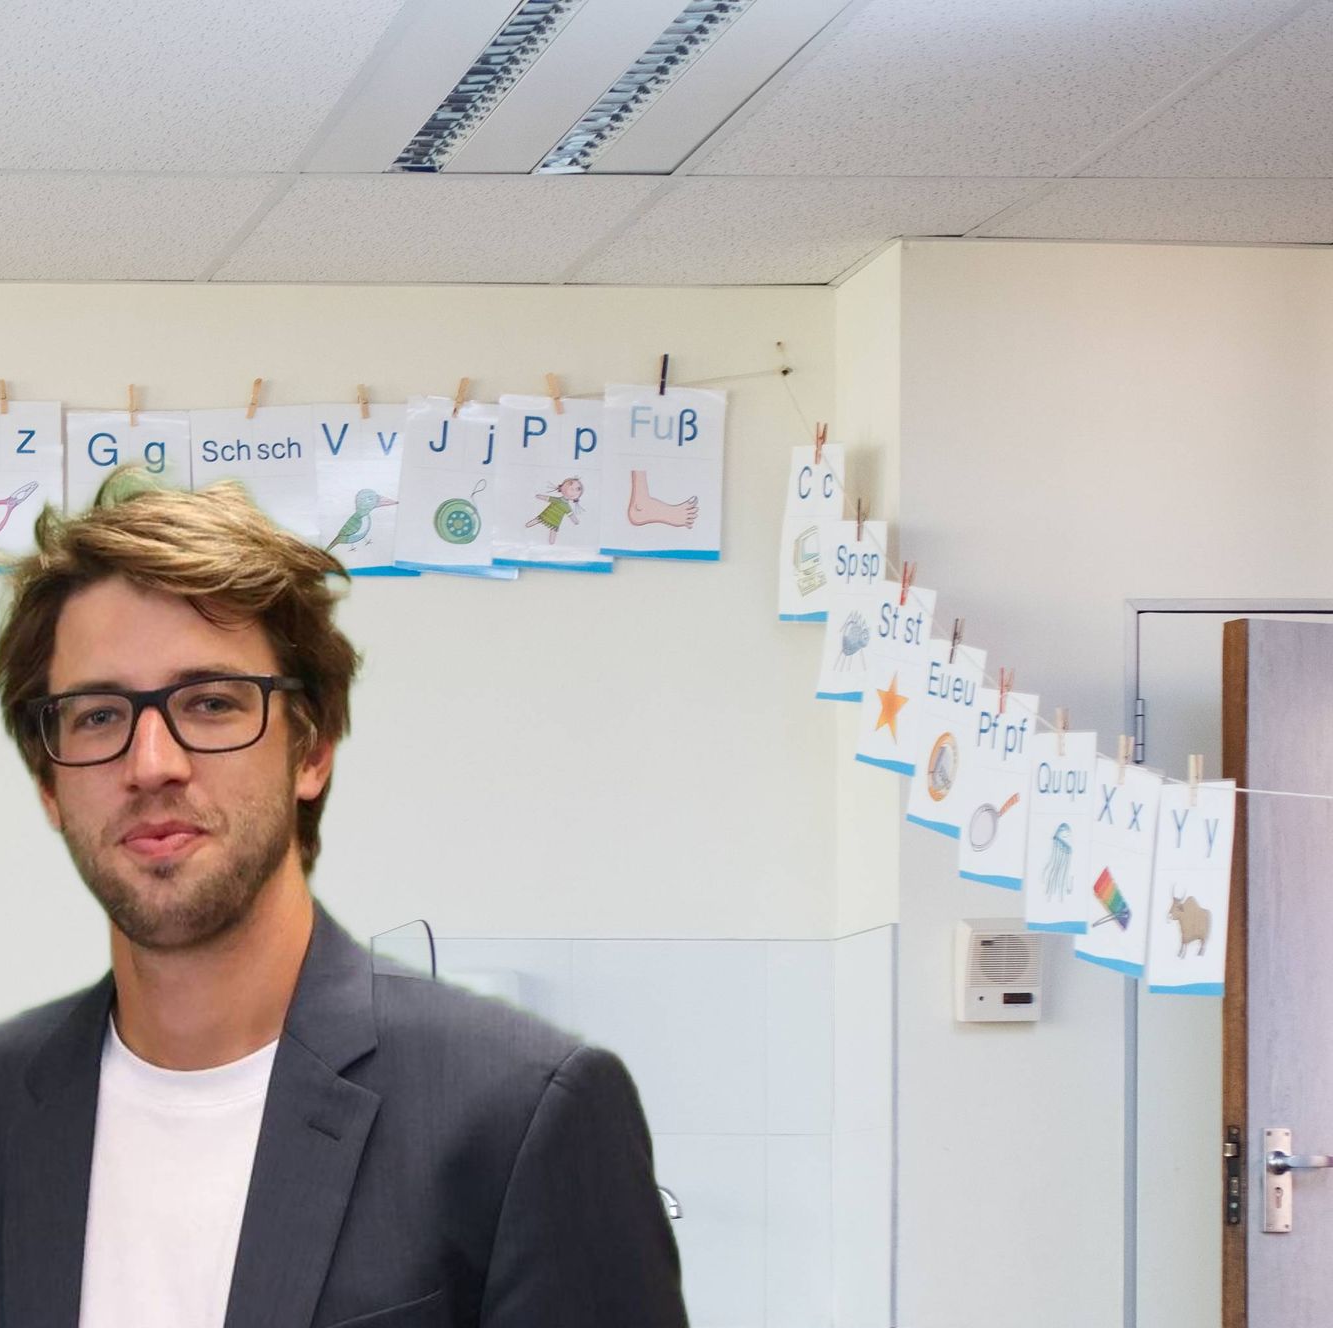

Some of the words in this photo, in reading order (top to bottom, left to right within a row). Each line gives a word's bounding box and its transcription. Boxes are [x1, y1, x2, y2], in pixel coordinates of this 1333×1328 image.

[16, 430, 35, 453] z
[322, 423, 349, 455] V
[377, 431, 397, 456] v
[429, 420, 449, 453] J
[483, 425, 494, 465] j
[523, 416, 547, 448] P
[575, 427, 597, 459] p
[630, 406, 698, 446] Fuß
[88, 433, 118, 467] G
[144, 441, 165, 473] g
[798, 466, 812, 499] C
[823, 473, 833, 498] c
[1097, 784, 1117, 824] X
[1128, 802, 1142, 831] x
[1172, 809, 1189, 848] Y
[1205, 818, 1219, 858] y
